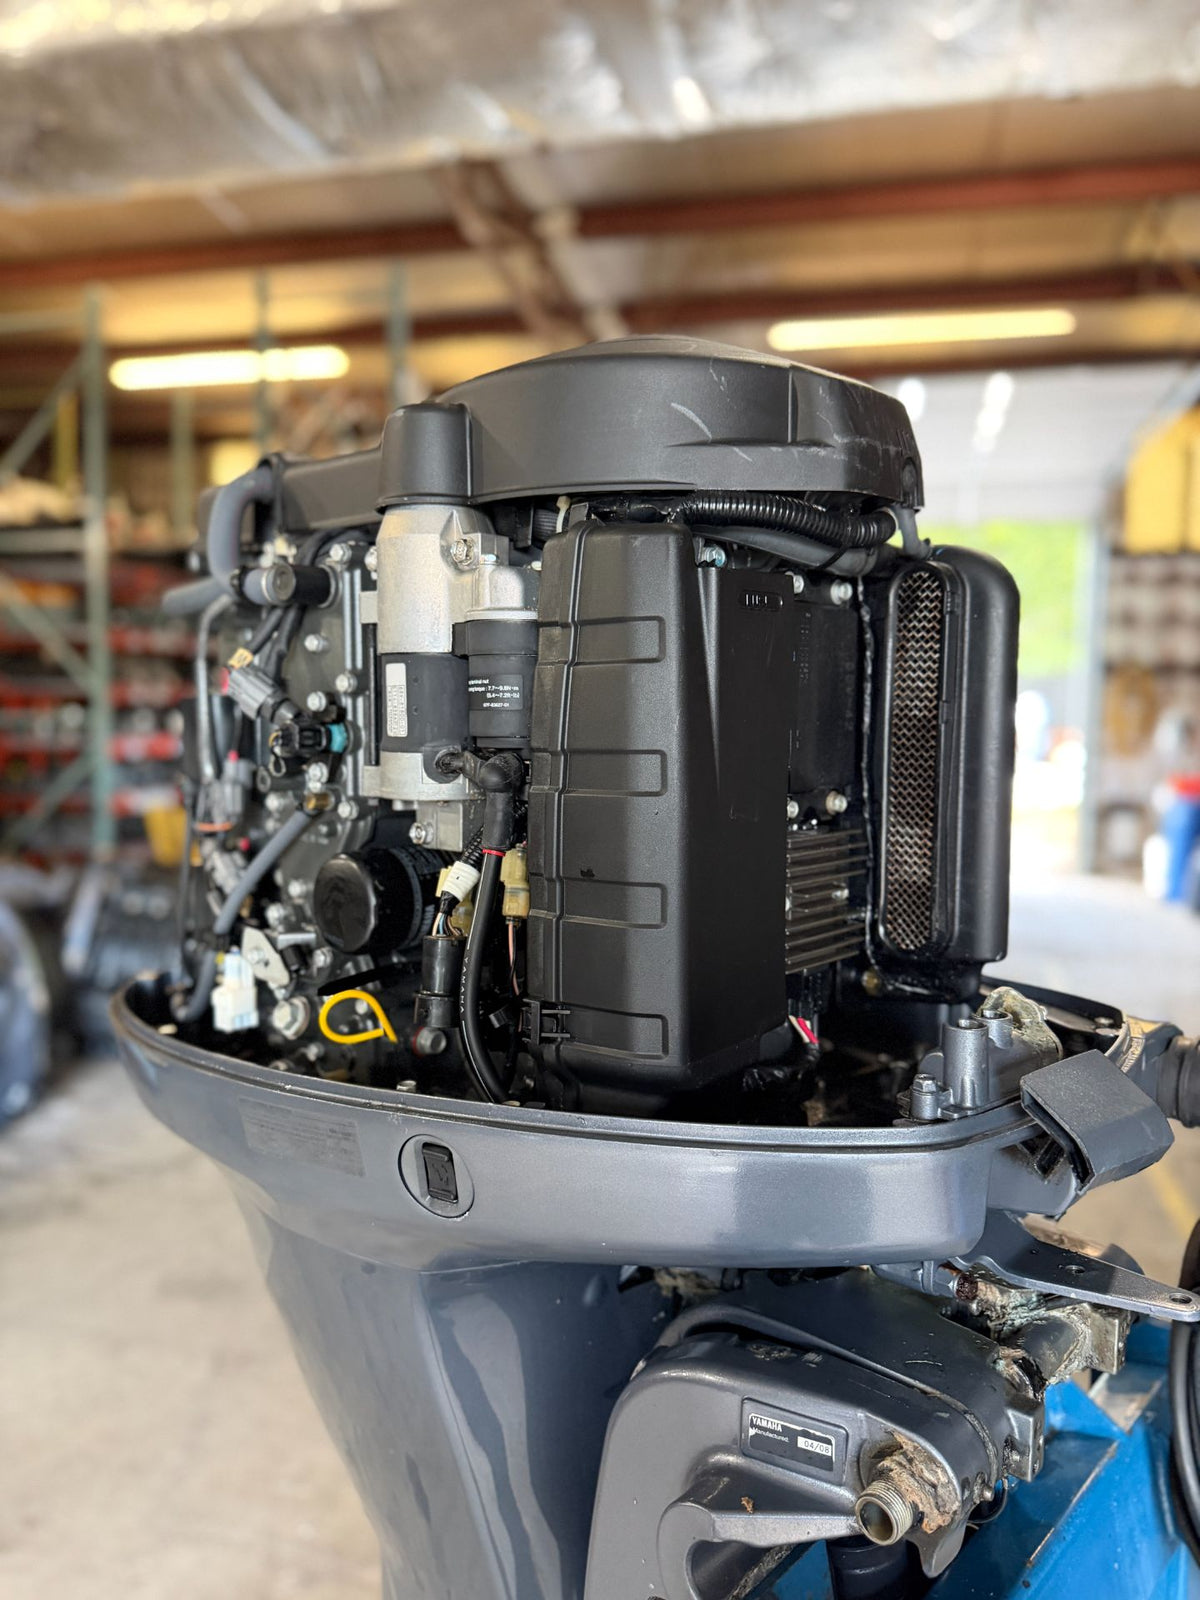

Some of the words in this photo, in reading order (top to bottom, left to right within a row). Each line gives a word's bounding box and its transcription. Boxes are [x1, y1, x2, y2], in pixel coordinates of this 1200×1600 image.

[460, 957, 469, 1013] YAMAHA
[752, 1416, 782, 1432] YAMAHA
[803, 1440, 830, 1454] 04/08
